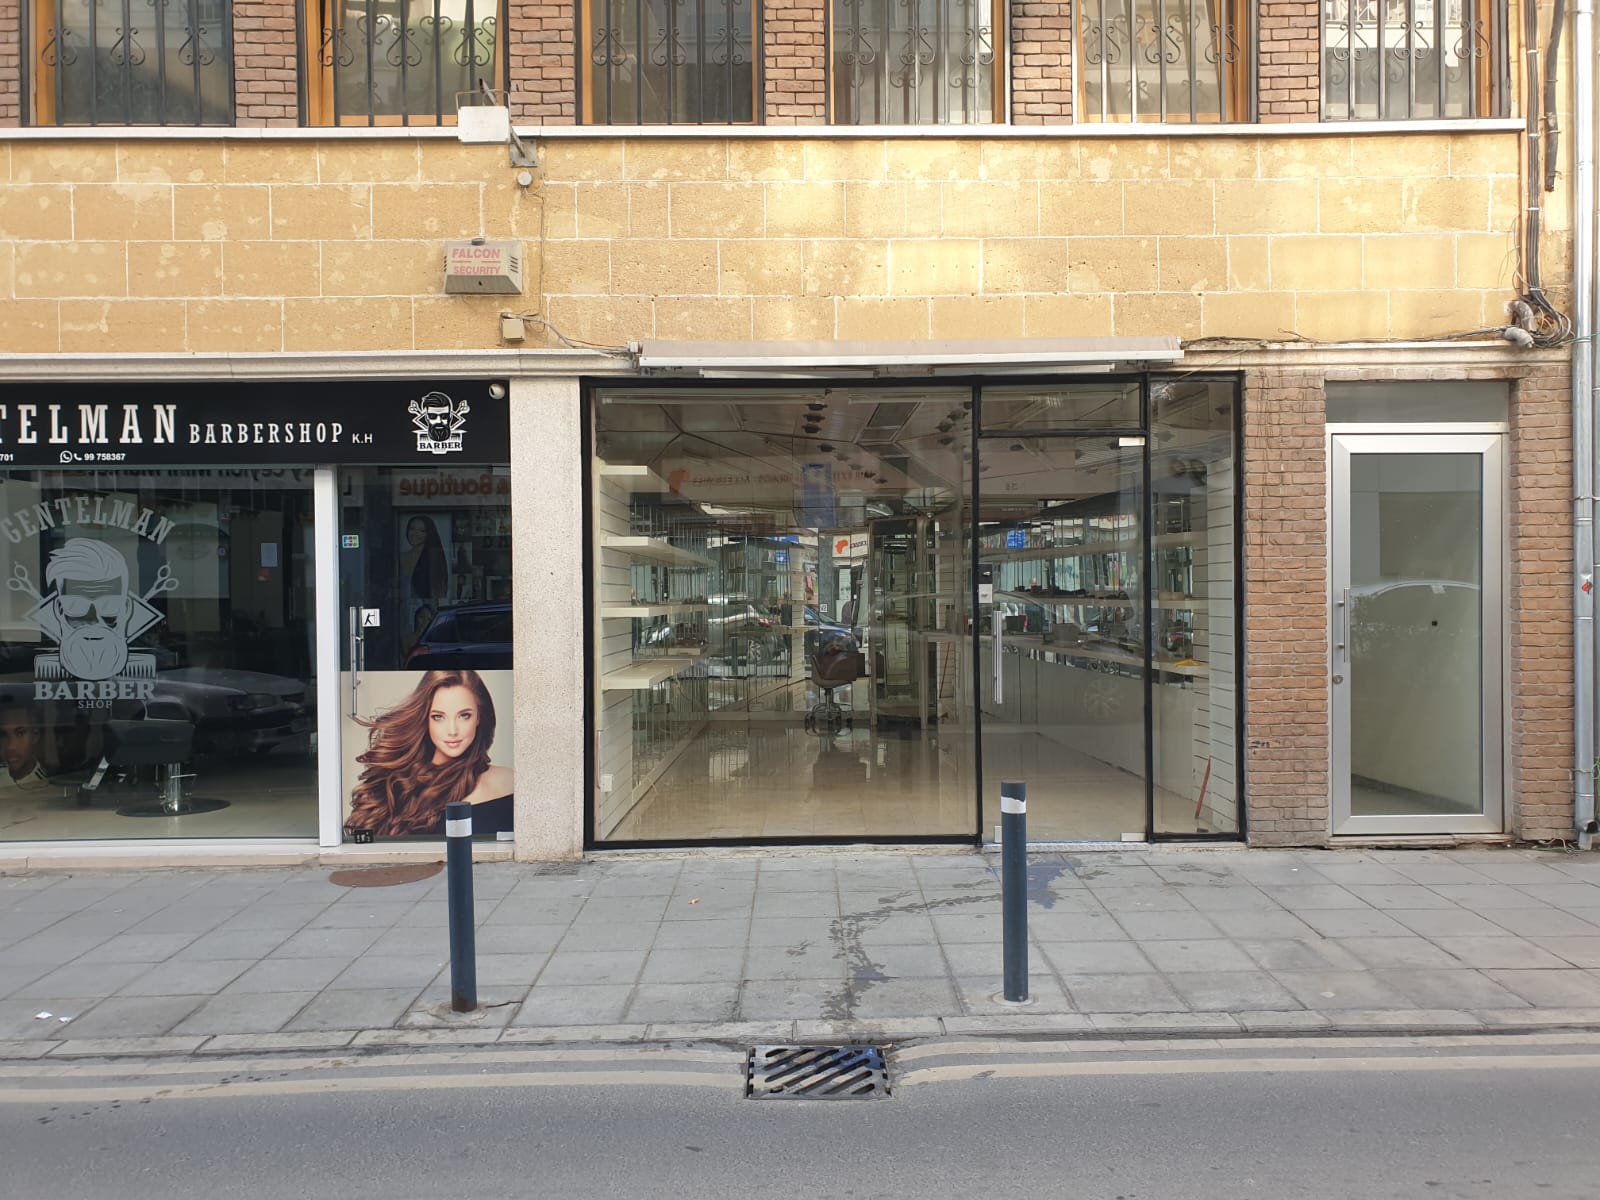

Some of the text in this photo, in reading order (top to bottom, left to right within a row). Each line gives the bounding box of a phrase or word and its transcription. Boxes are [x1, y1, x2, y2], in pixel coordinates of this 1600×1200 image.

[452, 248, 501, 259] FALCON
[453, 265, 501, 275] SECURITY
[189, 423, 343, 444] BARBERSHOP
[352, 433, 374, 444] K.H
[419, 441, 461, 450] BARBER
[83, 453, 126, 462] 99 758367
[1, 497, 176, 545] GENTELMAN
[33, 680, 156, 700] BARBER
[78, 700, 113, 709] SHOP
